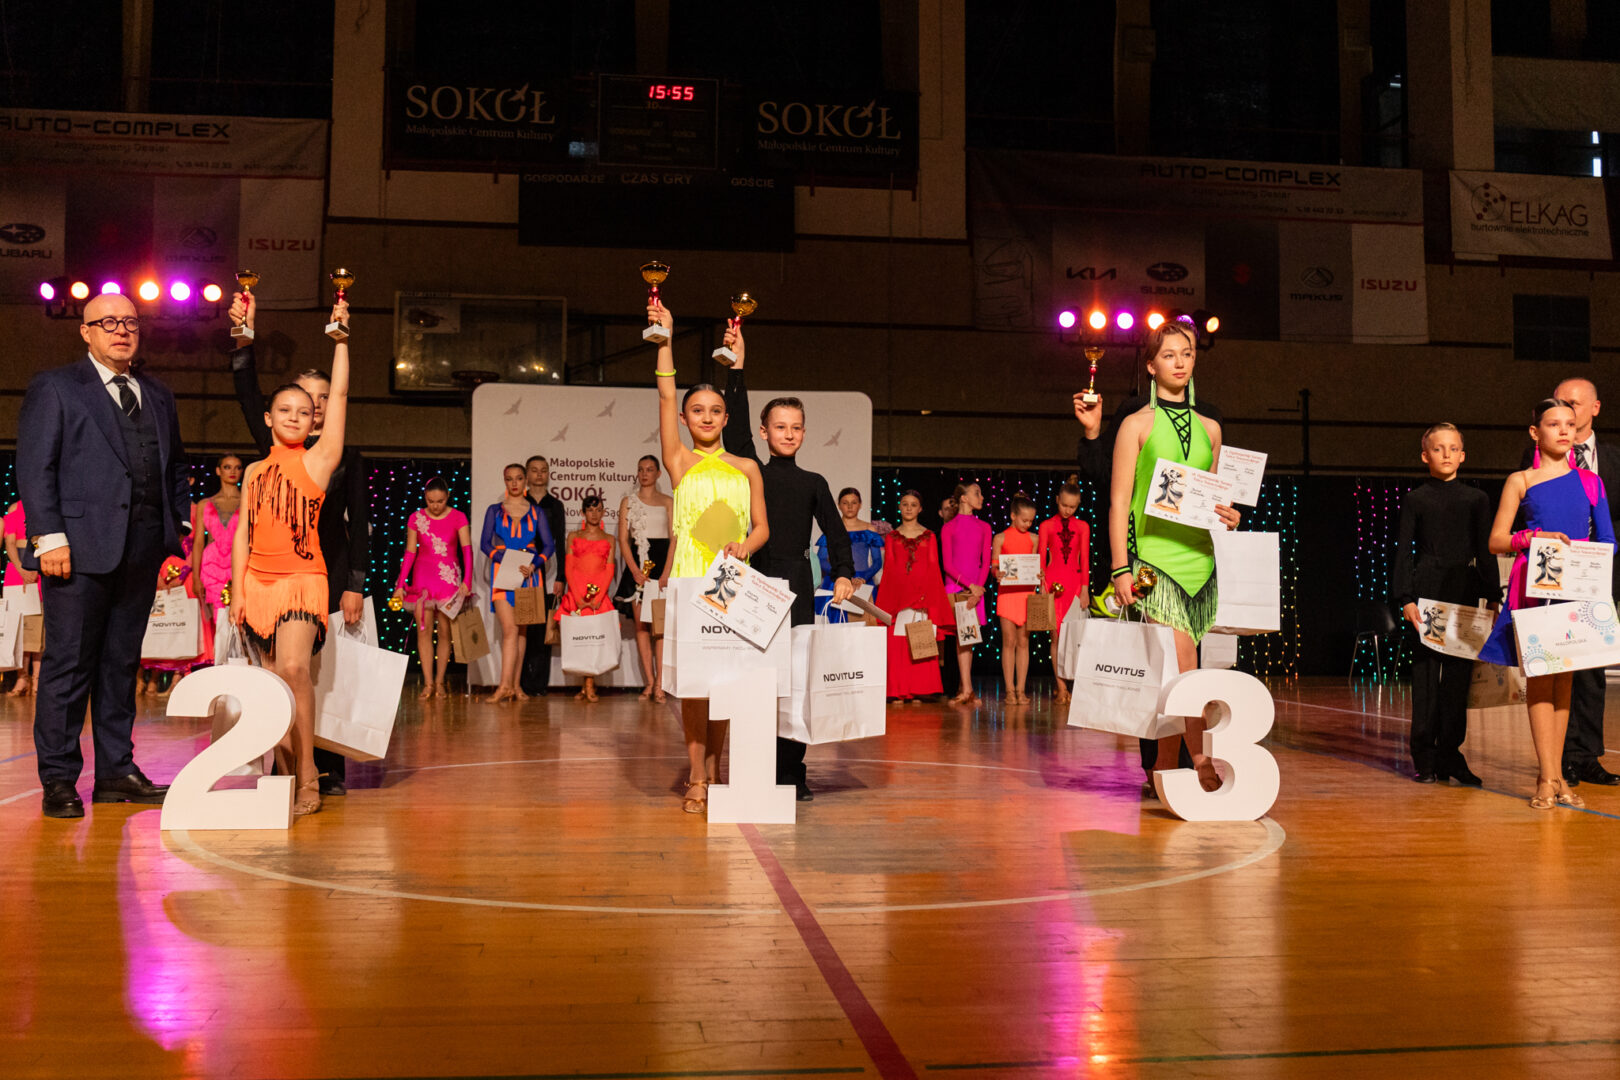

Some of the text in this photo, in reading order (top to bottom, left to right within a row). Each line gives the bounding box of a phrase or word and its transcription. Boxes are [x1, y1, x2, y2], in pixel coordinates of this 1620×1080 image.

[648, 85, 695, 101] 15:55
[469, 127, 515, 139] Centrum
[517, 128, 554, 143] Kultury
[818, 141, 863, 154] Centrum
[523, 173, 606, 185] GOSPODARZE
[620, 173, 694, 185] CZAS GRY
[1140, 163, 1341, 187] AUTO-COMPLEX
[248, 238, 316, 252] ISUZU
[1066, 266, 1117, 281] KIA
[1140, 285, 1195, 296] SUBARU
[1360, 278, 1418, 292] ISUZU
[550, 457, 616, 471] Małopolskie
[550, 471, 638, 484] Centrum Kultury
[550, 484, 608, 502] SOKÓŁ
[823, 670, 865, 683] NOVITUS
[1095, 662, 1147, 679] NOVITUS
[161, 664, 296, 831] 2
[706, 668, 797, 824] 1
[1154, 669, 1281, 822] 3
